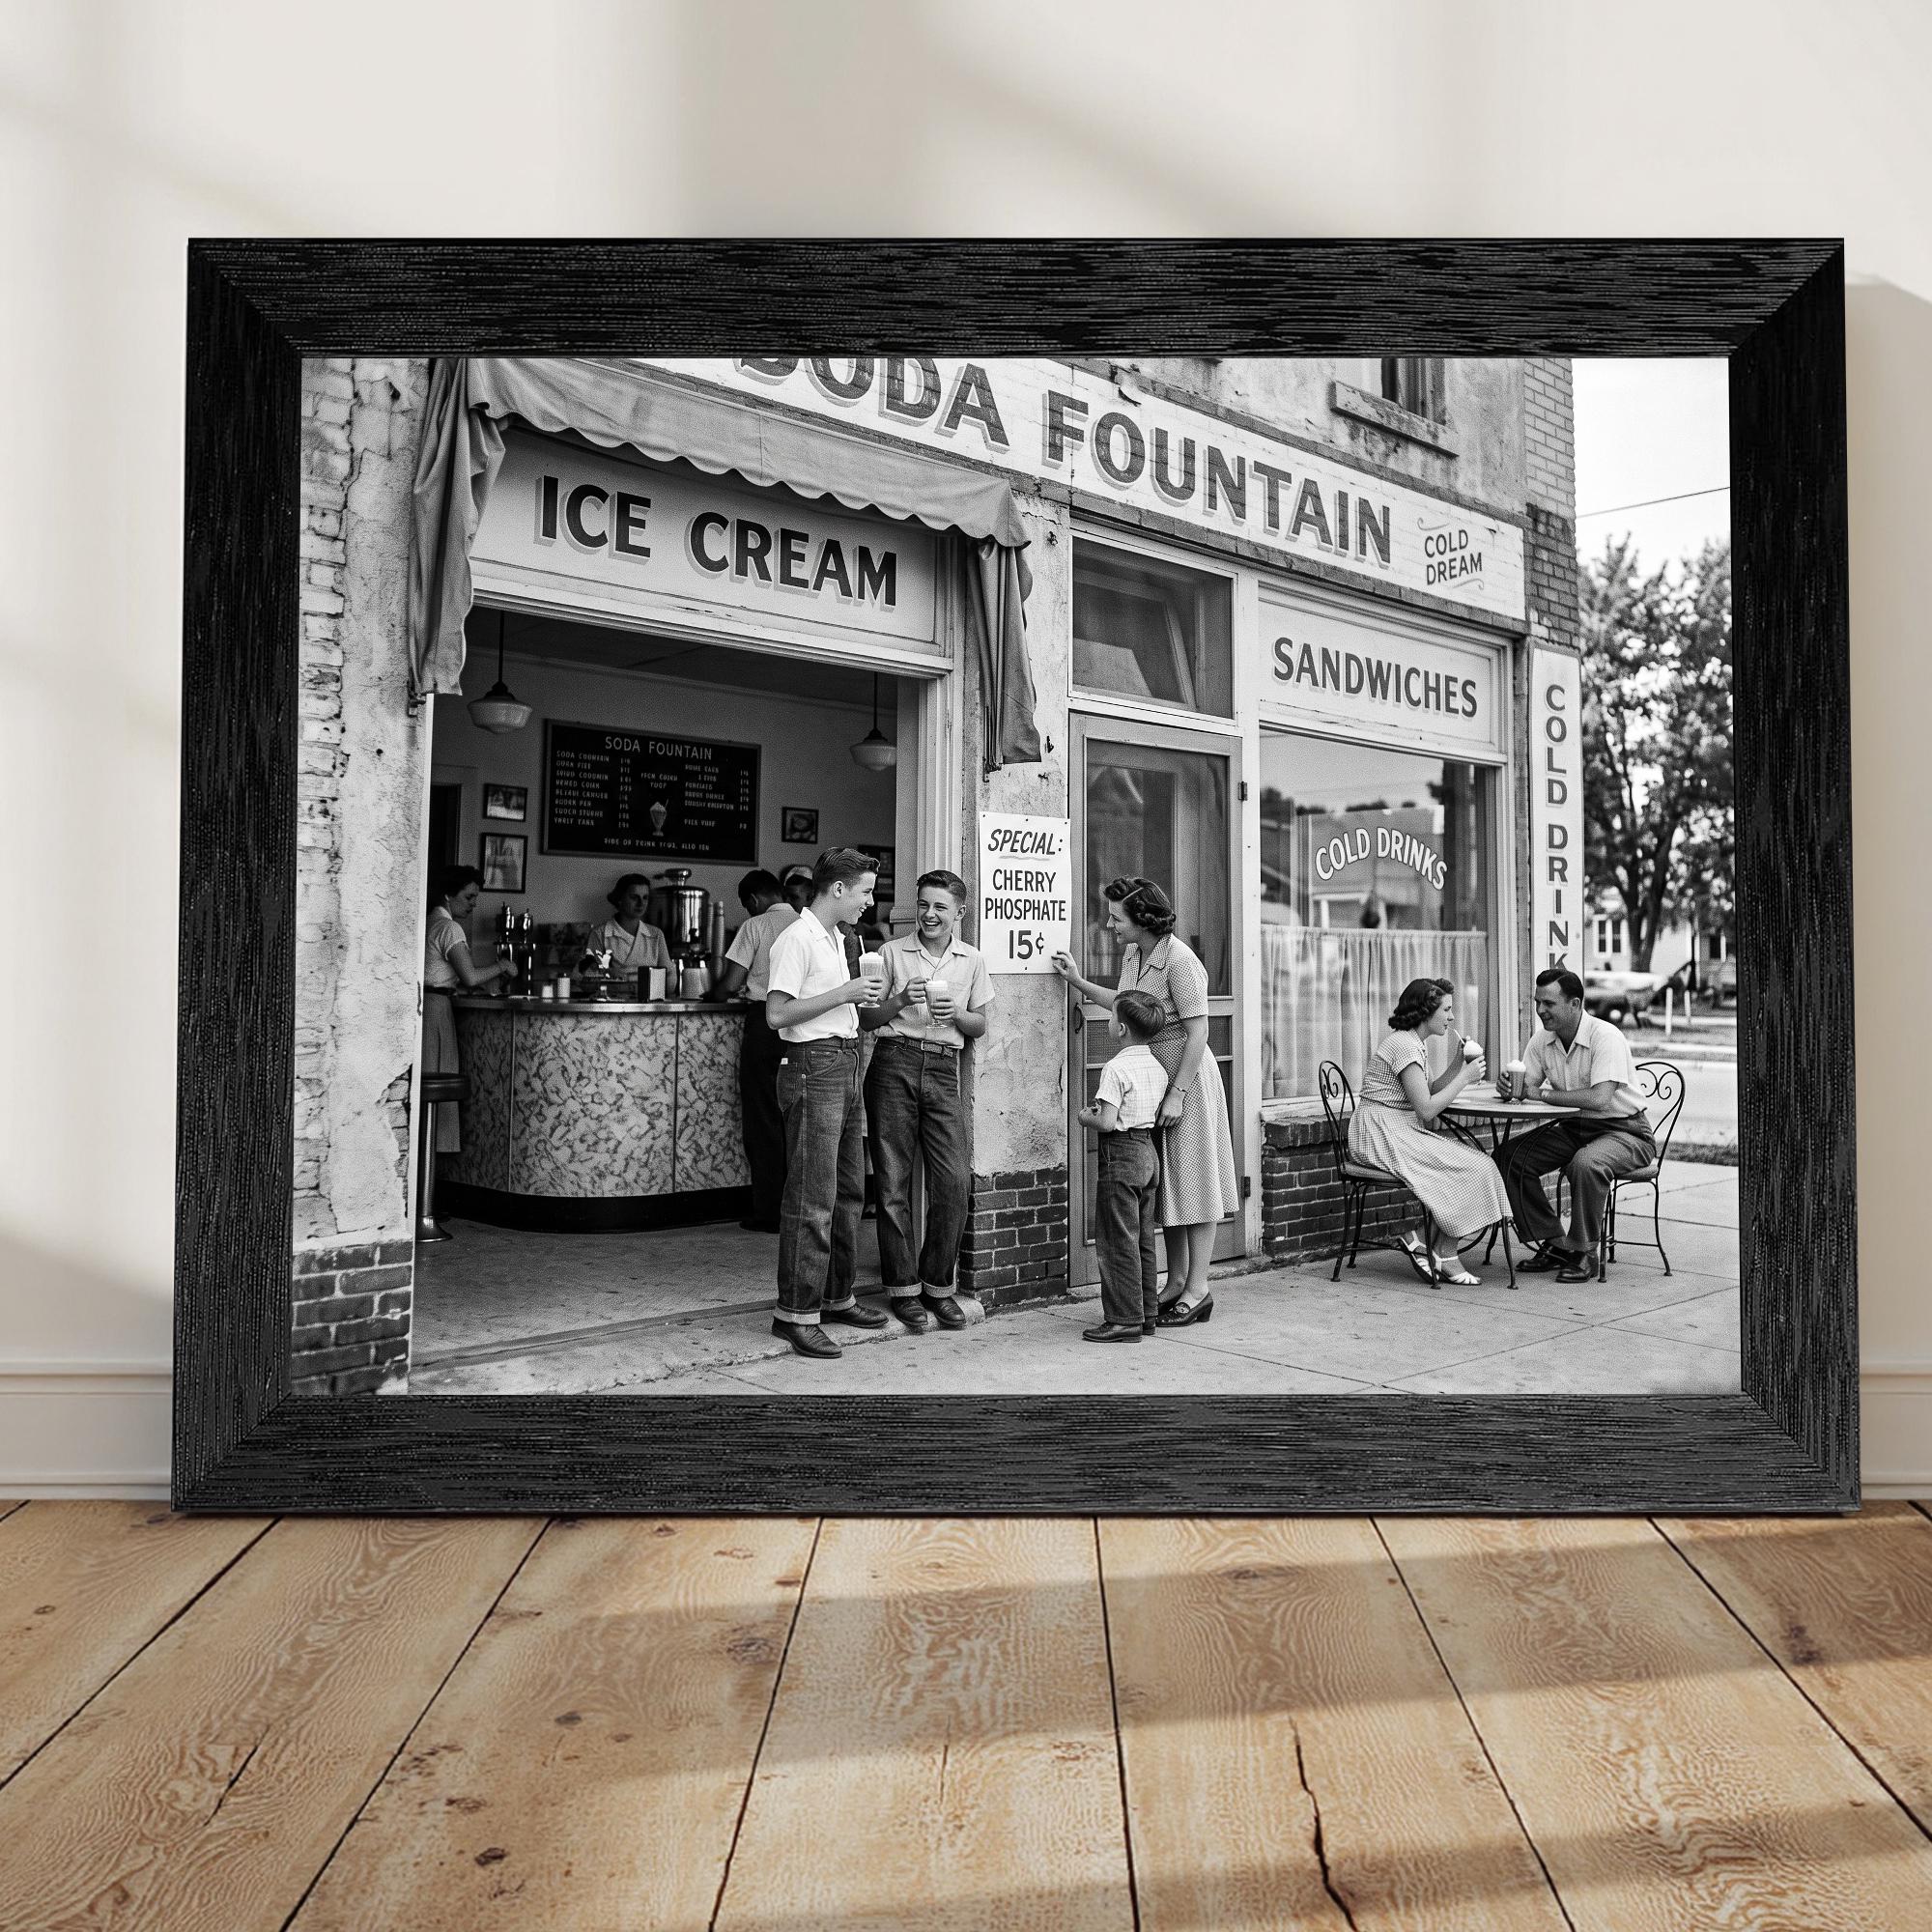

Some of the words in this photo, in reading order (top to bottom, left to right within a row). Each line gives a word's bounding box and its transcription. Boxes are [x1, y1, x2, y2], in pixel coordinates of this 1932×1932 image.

[732, 358, 1010, 454] ODA
[1042, 389, 1391, 568] FOUNTAIN
[533, 474, 652, 567] ICE
[684, 511, 898, 612] CREAM
[1424, 528, 1469, 558] COLD
[1425, 552, 1484, 586] DREAM
[1272, 636, 1478, 719] SANDWICHES
[605, 735, 640, 753] SODA
[648, 740, 713, 761] FOUNTAIN
[1545, 683, 1568, 807] COLD
[987, 828, 1064, 856] SPECIAL:
[1315, 827, 1371, 880] COLD
[1377, 826, 1448, 891] DRINKS
[992, 868, 1057, 894] CHERRY
[984, 896, 1066, 922] PHOSPHATE
[1009, 929, 1044, 960] 15¢
